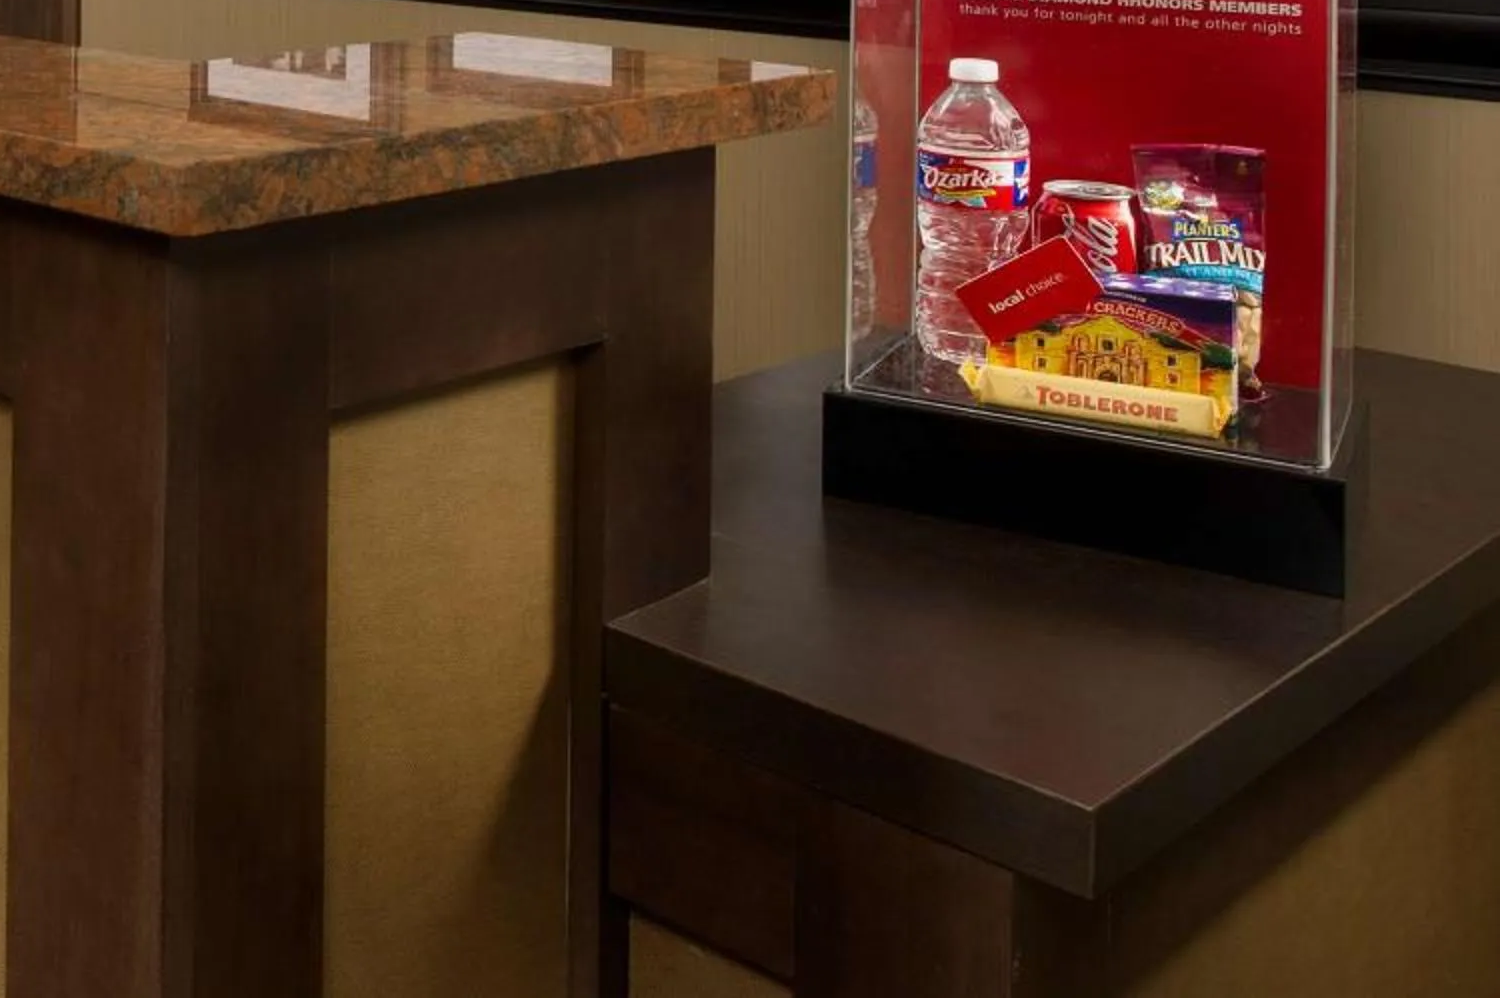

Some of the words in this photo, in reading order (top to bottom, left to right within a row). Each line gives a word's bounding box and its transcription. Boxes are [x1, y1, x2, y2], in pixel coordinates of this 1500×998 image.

[959, 3, 998, 16] thank
[1003, 8, 1029, 19] you
[1034, 6, 1053, 19] for
[1060, 9, 1113, 25] tonight
[1118, 13, 1146, 25] and
[1150, 15, 1169, 27] all
[1175, 16, 1200, 29] the
[1205, 18, 1247, 31] other
[1252, 21, 1303, 36] nights
[1209, 0, 1303, 17] MEMBERS
[924, 166, 997, 188] Ozarka
[1174, 221, 1241, 239] PLANTERS
[1145, 240, 1220, 268] TRAIL
[987, 289, 1025, 314] local
[1025, 272, 1064, 297] choice
[1093, 301, 1181, 333] CRACKERS
[1036, 385, 1179, 422] TOBLERONE
